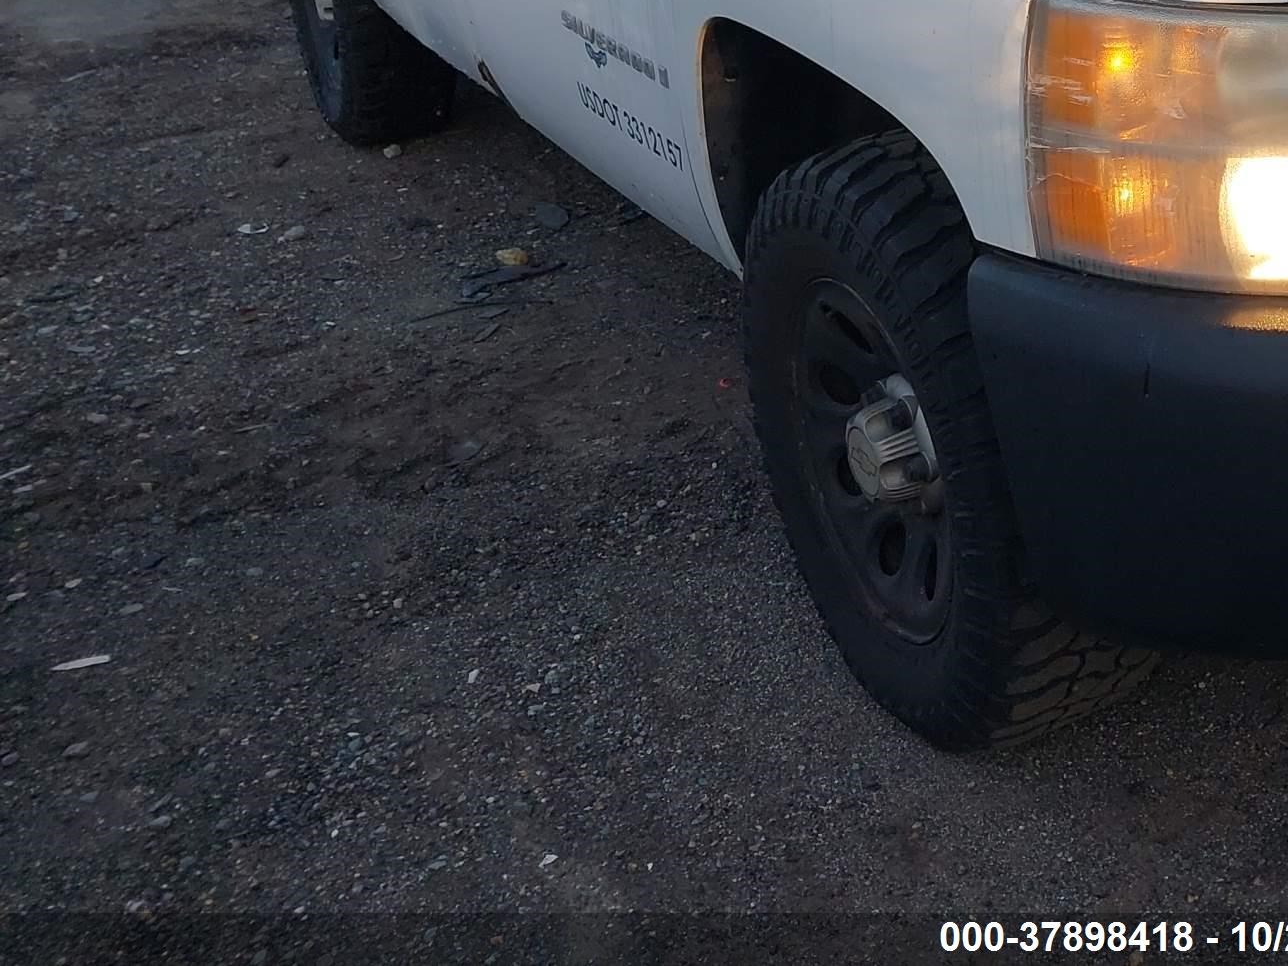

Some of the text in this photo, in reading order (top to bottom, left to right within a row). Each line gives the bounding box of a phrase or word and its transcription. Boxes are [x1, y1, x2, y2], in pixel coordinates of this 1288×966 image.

[561, 8, 656, 82] SILVERADO
[577, 80, 684, 172] USDOT 3312157
